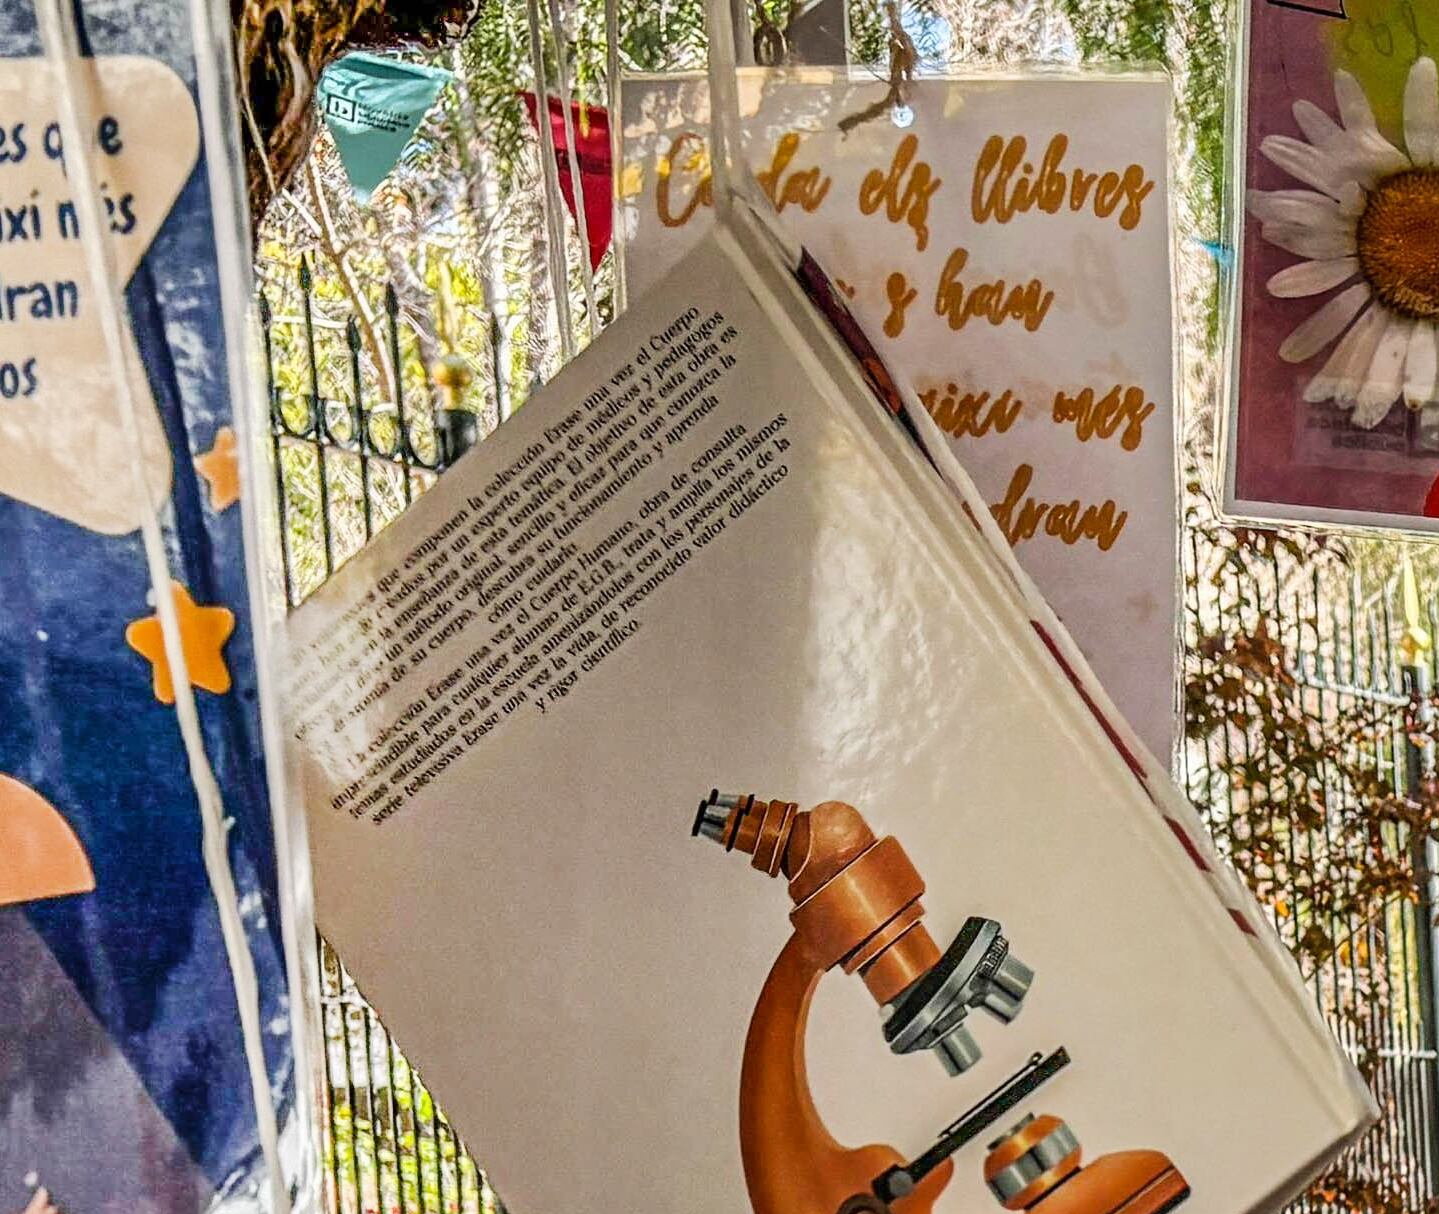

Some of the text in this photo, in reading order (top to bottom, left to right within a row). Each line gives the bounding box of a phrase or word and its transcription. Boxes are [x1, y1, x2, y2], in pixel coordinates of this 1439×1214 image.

[43, 115, 123, 179] qe
[972, 132, 1156, 231] llibres
[375, 568, 400, 594] que
[403, 509, 469, 570] componen
[483, 442, 545, 498] colección
[582, 385, 610, 411] una
[609, 363, 635, 386] vez
[635, 346, 651, 366] el
[648, 306, 700, 351] Cuerpo
[392, 568, 460, 628] enseñanza
[478, 526, 509, 554] esta
[583, 413, 637, 463] objetivo
[657, 371, 687, 399] esta
[686, 342, 719, 372] obra
[402, 599, 454, 645] método
[506, 510, 556, 555] sencillo
[568, 465, 607, 502] eficaz
[606, 438, 638, 471] para
[638, 414, 665, 440] que
[665, 367, 721, 417] conozca
[424, 550, 449, 577] por
[469, 489, 521, 536] experto
[519, 450, 566, 492] equipo
[584, 383, 641, 435] médicos
[652, 311, 724, 379] pedagogos
[463, 645, 492, 670] una
[489, 622, 516, 645] vez
[528, 568, 579, 612] Cuerpo
[638, 489, 670, 519] obra
[690, 424, 747, 474] consulta
[476, 554, 536, 608] descubra
[552, 452, 652, 540] funcionamiento
[664, 394, 719, 445] aprenda
[389, 723, 457, 785] estudiados
[490, 653, 540, 697] escuela
[635, 547, 662, 573] con
[659, 528, 684, 550] los
[683, 467, 755, 535] personajes
[419, 704, 452, 736] para
[450, 652, 509, 706] cualquier
[511, 610, 559, 655] alumno
[621, 527, 657, 558] trata
[667, 478, 713, 520] amplía
[710, 458, 735, 480] los
[734, 412, 788, 462] mismos
[487, 589, 524, 623] cómo
[501, 690, 527, 714] una
[526, 667, 552, 690] vez
[617, 547, 692, 613] reconocido
[691, 516, 726, 548] valor
[728, 463, 788, 519] didáctico
[545, 669, 578, 702] rigor
